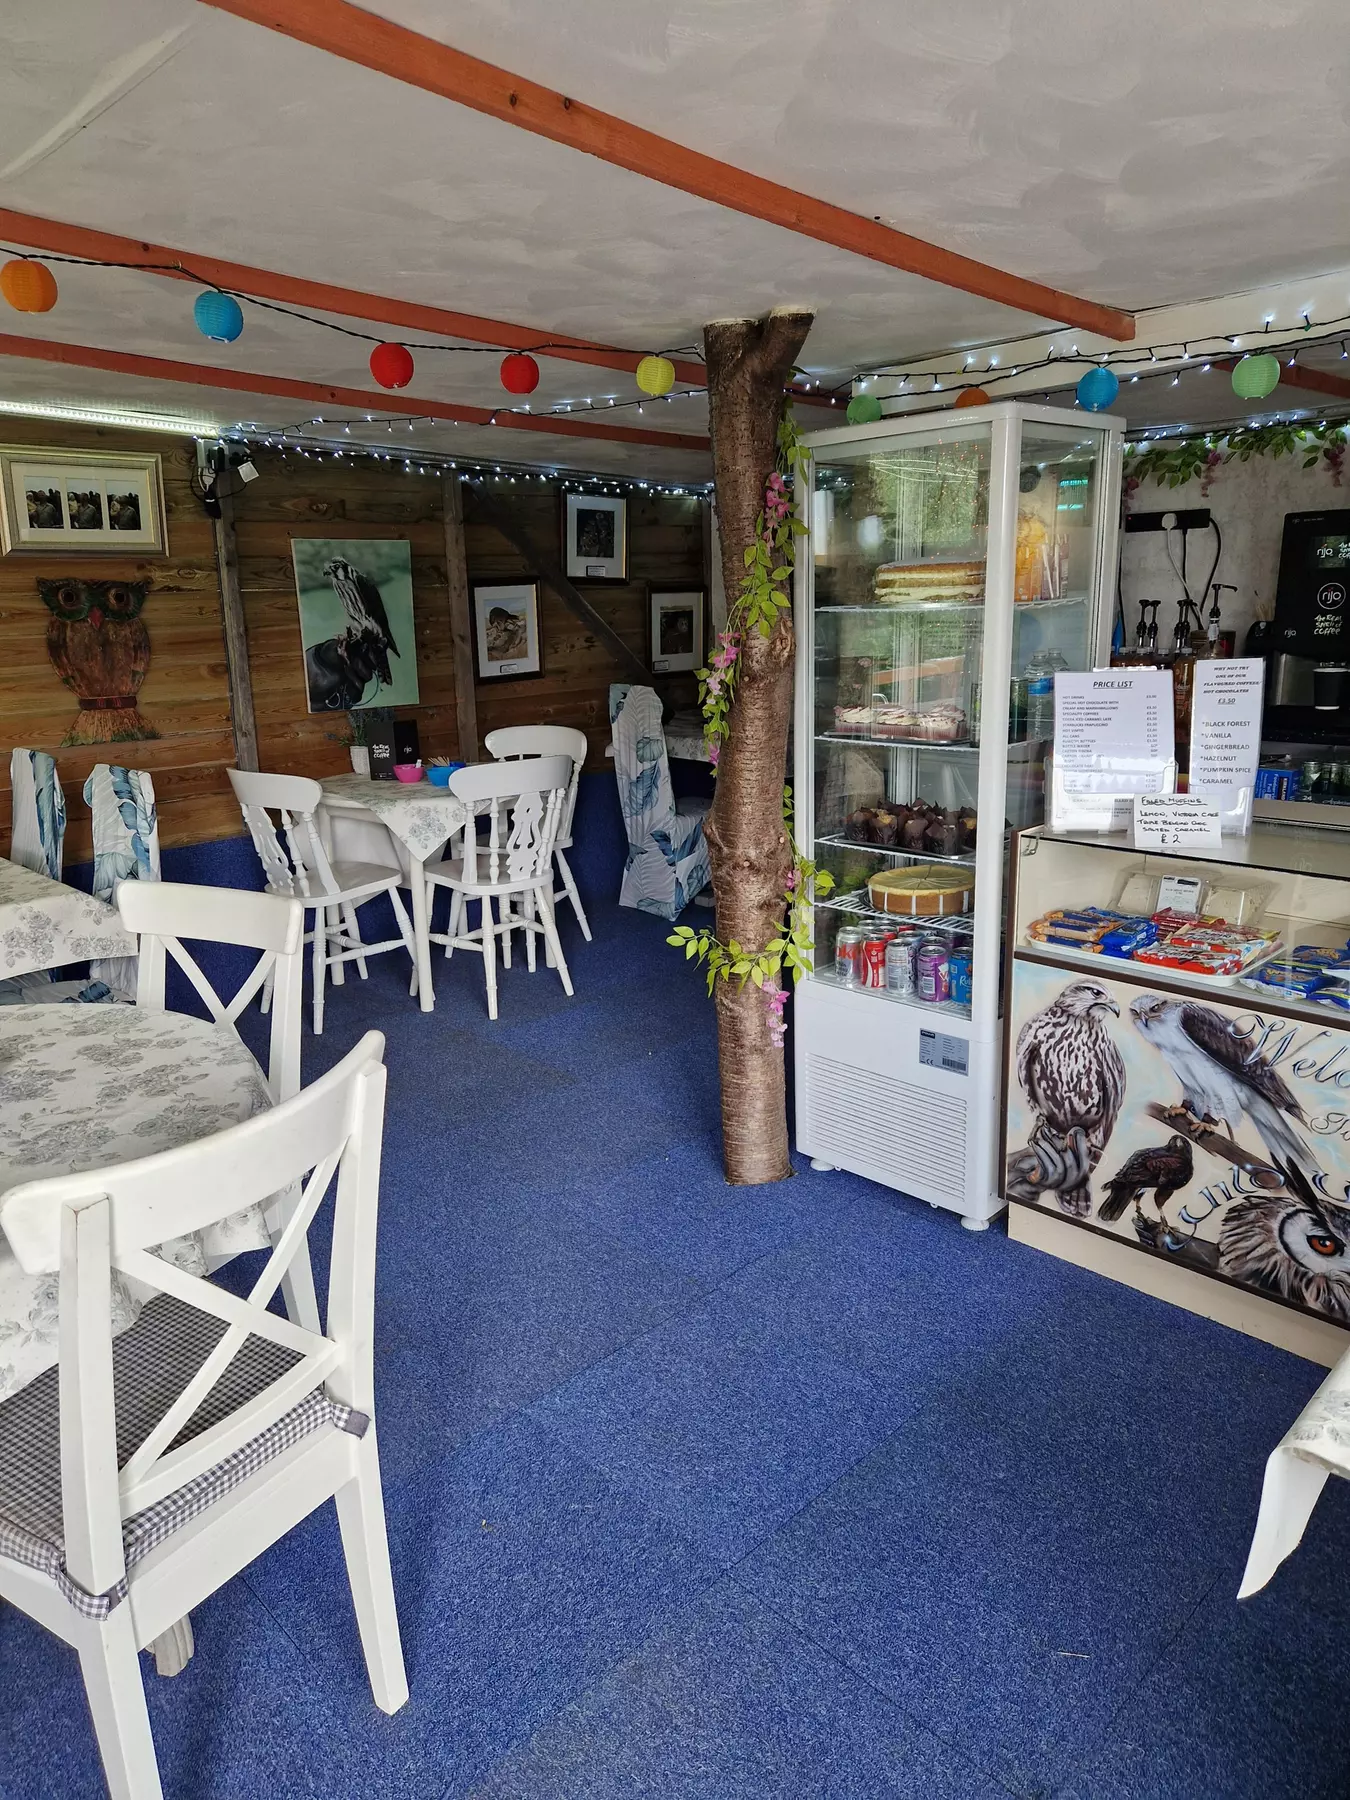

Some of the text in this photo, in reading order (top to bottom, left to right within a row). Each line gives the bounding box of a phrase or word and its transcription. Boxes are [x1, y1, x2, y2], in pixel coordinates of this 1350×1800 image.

[1316, 544, 1333, 558] rijo
[1322, 587, 1342, 604] rijo
[1284, 628, 1296, 638] rijo
[1314, 628, 1340, 636] coffee
